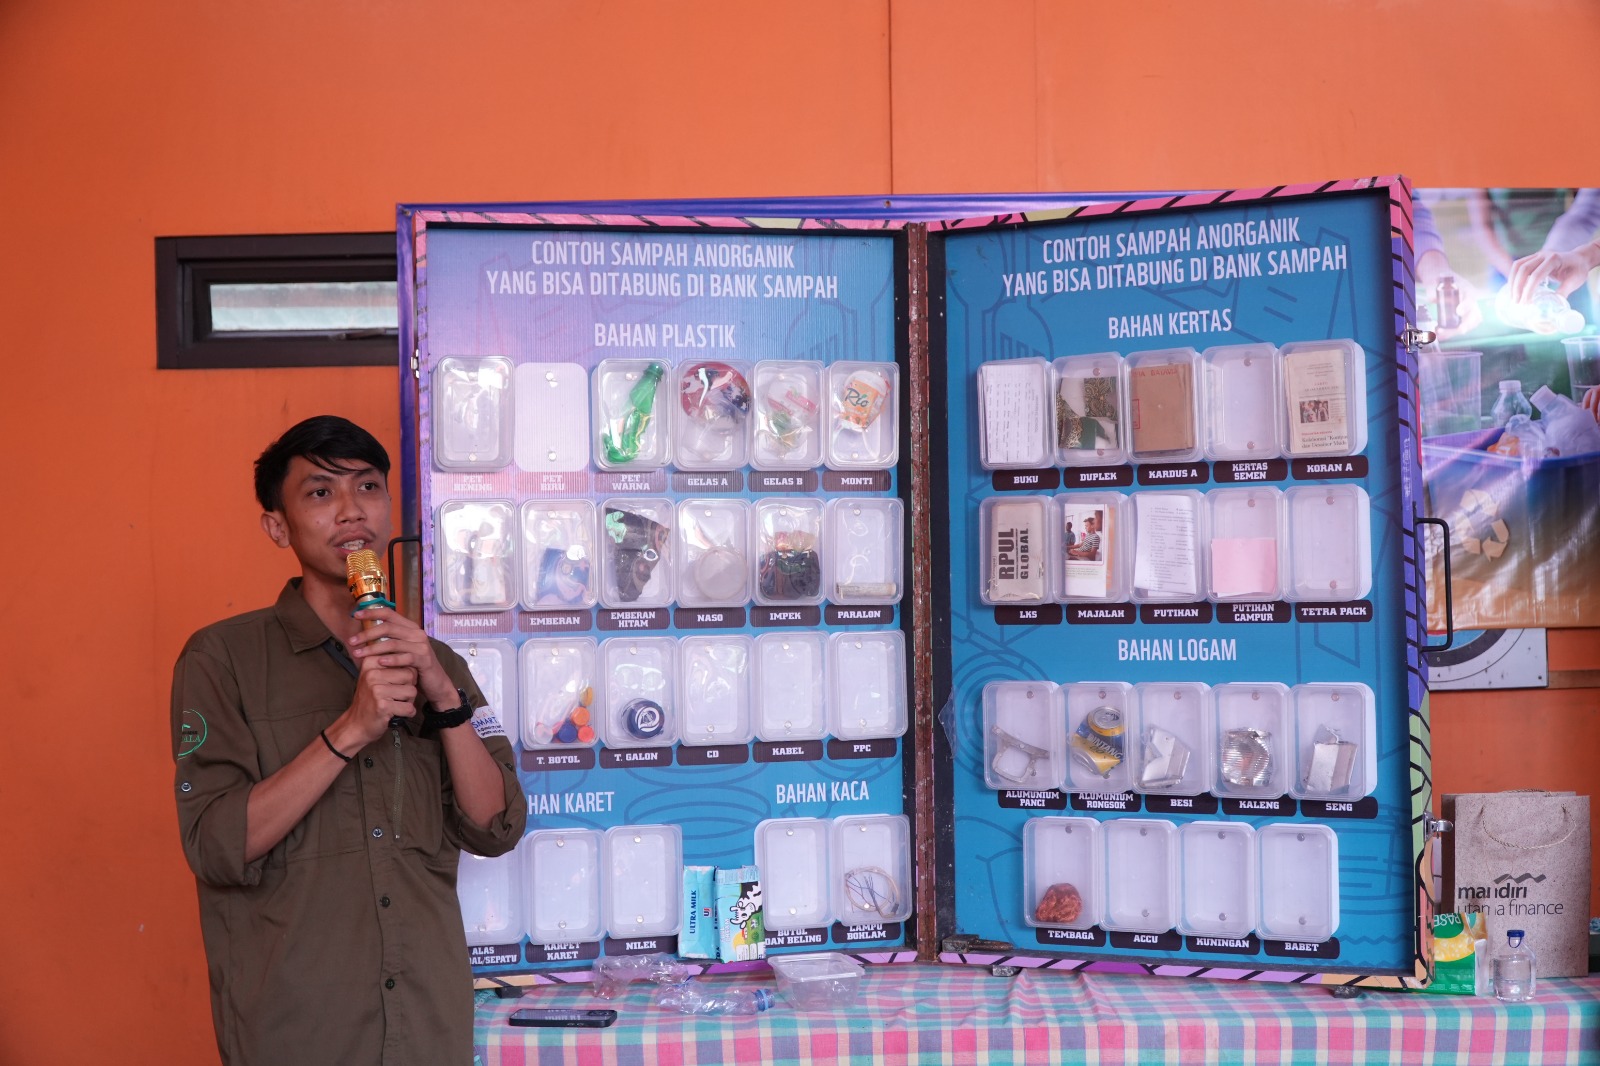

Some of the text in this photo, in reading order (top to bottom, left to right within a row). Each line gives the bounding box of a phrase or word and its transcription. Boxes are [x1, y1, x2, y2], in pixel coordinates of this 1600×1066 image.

[1043, 217, 1300, 264] CONTOH SAMPAH ANORGANIK
[532, 241, 794, 268] CONTOH SAMPAH ANORGANIK
[1002, 244, 1347, 297] YANG BISA DITABUNG DI BANK SAMPAH
[486, 270, 838, 299] YANG BISA DITABUNG DI BANK SAMPAH
[1108, 308, 1232, 339] BAHAN KERTAS
[594, 323, 736, 348] BAHAN PLASTIK
[845, 387, 869, 407] Rio
[1232, 462, 1268, 472] KERTAS
[1306, 463, 1353, 473] KORAN A
[621, 474, 640, 482] PET
[1080, 472, 1117, 482] DUPLEK
[1148, 469, 1198, 479] KARDUS A
[1234, 471, 1266, 480] SEMEN
[462, 475, 483, 483] PET
[543, 475, 563, 483] PET
[687, 477, 728, 486] GELAS A
[763, 477, 803, 486] GELAS B
[841, 477, 873, 485] MONTI
[1013, 475, 1039, 484] BUKU
[541, 482, 565, 491] BIRU
[612, 482, 650, 491] WARNA
[998, 528, 1014, 579] RPUL
[1020, 528, 1029, 579] GLOBAL
[1232, 603, 1275, 612] PUTIHAN
[1301, 607, 1367, 616] TETRA PACK
[611, 611, 656, 620] EMBERAN
[769, 612, 801, 620] IMPEK
[837, 610, 881, 619] PARALON
[1019, 610, 1037, 619] LKS
[1078, 609, 1124, 618] MAJALAH
[1153, 609, 1199, 617] PUTIHAN
[1234, 613, 1273, 622] CAMPUR
[454, 618, 497, 627] MAINAN
[529, 617, 581, 626] EMBERAN
[697, 614, 723, 622] NASO
[618, 619, 648, 628] HITAM
[1118, 638, 1237, 661] BAHAN LOGAM
[471, 716, 498, 728] SMART
[853, 744, 871, 752] PPC
[1087, 733, 1123, 759] BINTANG
[706, 750, 719, 758] CD
[772, 747, 804, 756] KABEL
[537, 755, 580, 764] T. BOTOL
[614, 752, 658, 762] T. GALON
[776, 780, 870, 804] BAHAN KACA
[1006, 790, 1059, 799] ALUMUNIUM
[1078, 792, 1134, 801] ALUMUNIUM
[527, 791, 614, 815] HAN KARET
[1020, 799, 1045, 807] PANCI
[1086, 800, 1126, 809] RONGSOK
[1170, 799, 1193, 807] BESI
[1239, 800, 1280, 809] KALENG
[1325, 802, 1353, 812] SENG
[1509, 899, 1564, 915] finance
[849, 923, 883, 932] LAMPU
[777, 928, 808, 937] BOTOL
[847, 930, 886, 940] BOHLAM
[1048, 930, 1094, 940] TEMBAGA
[765, 934, 822, 946] DAN BELING
[1133, 934, 1158, 944] ACCU
[1196, 938, 1249, 948] KUNINGAN
[626, 941, 657, 950] NILEK
[1284, 942, 1319, 952] BABET
[472, 946, 494, 955] ALAS
[546, 951, 578, 960] KARET
